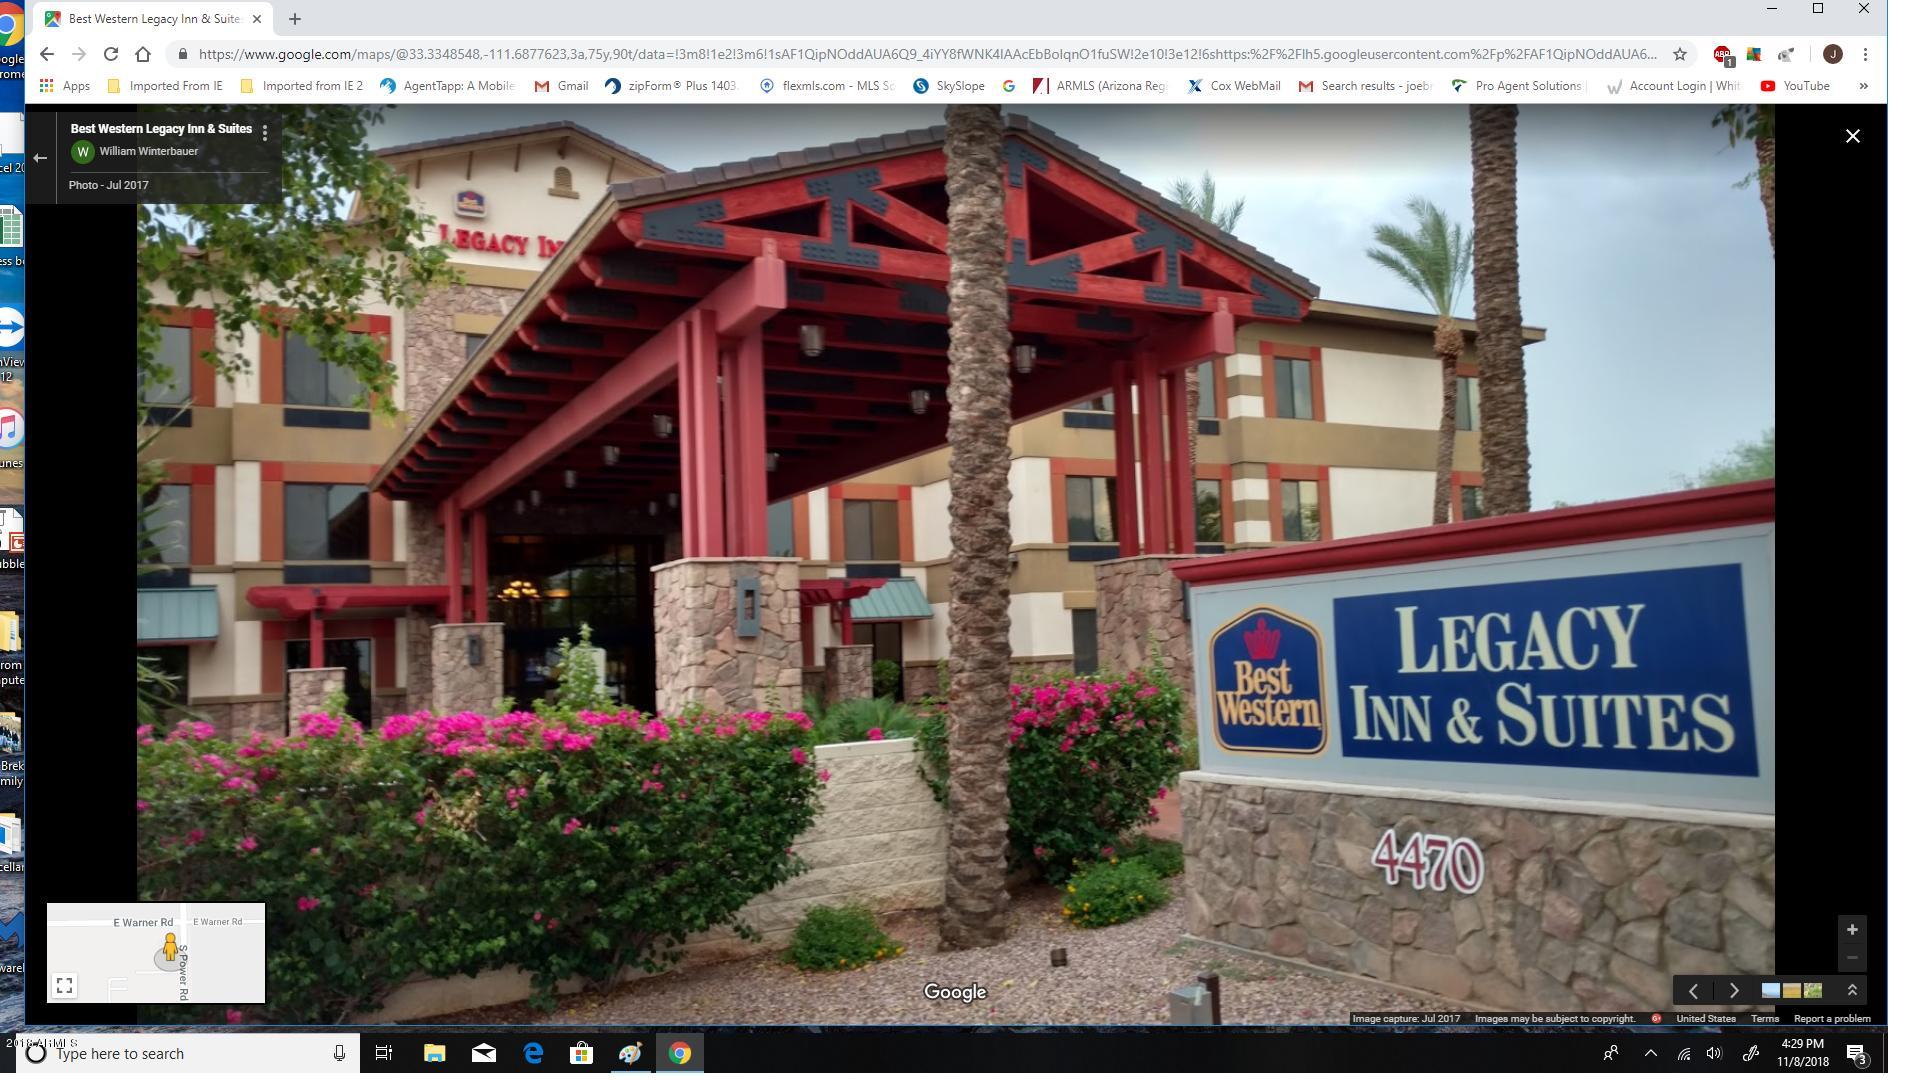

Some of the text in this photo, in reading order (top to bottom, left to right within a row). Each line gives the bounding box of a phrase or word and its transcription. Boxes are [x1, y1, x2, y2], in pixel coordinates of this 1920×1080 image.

[69, 14, 93, 24] Best
[94, 14, 139, 24] Western
[141, 14, 179, 27] Legacy
[182, 14, 198, 24] Inn
[201, 14, 212, 24] &
[1830, 50, 1836, 58] J
[0, 53, 24, 67] ogle
[62, 80, 91, 94] Apps
[130, 80, 223, 94] Imported From IE
[263, 80, 364, 94] Imported from IE 2
[404, 80, 515, 94] AgentTapp: A Mobile
[557, 80, 589, 91] Gmail
[686, 80, 708, 91] Plus
[782, 80, 846, 91] flexmls.com
[857, 80, 880, 91] MLS
[936, 80, 985, 94] SkySlope
[1056, 80, 1166, 94] ARMLS (Arizona Reg
[1210, 80, 1281, 91] Cox WebMail
[1321, 80, 1358, 91] Search
[1361, 80, 1396, 91] results
[1476, 80, 1582, 94] Pro Agent Solutions
[1629, 80, 1675, 91] Account
[1677, 80, 1707, 94] Login
[1783, 80, 1831, 91] YouTube
[70, 122, 253, 137] Best Western Legacy Inn & Suites
[77, 147, 89, 157] W
[100, 145, 199, 156] William Winterbauer
[69, 180, 99, 190] Photo
[106, 180, 122, 190] Jul
[124, 180, 150, 190] 2017
[438, 224, 528, 256] LEGACY
[1, 371, 13, 382] 12
[1394, 603, 1646, 674] LEGACY
[1233, 659, 1294, 696] Best
[1216, 690, 1322, 727] Western
[1349, 682, 1736, 754] INN & SUITES
[1371, 828, 1485, 895] 4470
[114, 917, 174, 927] E Warner Rd
[193, 917, 243, 926] E Warner Rd
[180, 944, 189, 1001] S Power Rd
[1353, 1014, 1461, 1025] Image capture: Jul 2017
[1475, 1014, 1637, 1025] Images may be subject to copyright.
[1676, 1014, 1737, 1023] United States
[1751, 1014, 1780, 1023] Terms
[1794, 1014, 1824, 1025] Report
[1834, 1014, 1872, 1025] problem
[1781, 1038, 1825, 1049] 4:29 PM
[56, 1047, 185, 1063] Type here to search
[1859, 1054, 1866, 1065] 3
[1777, 1056, 1830, 1068] 11/8/2018
